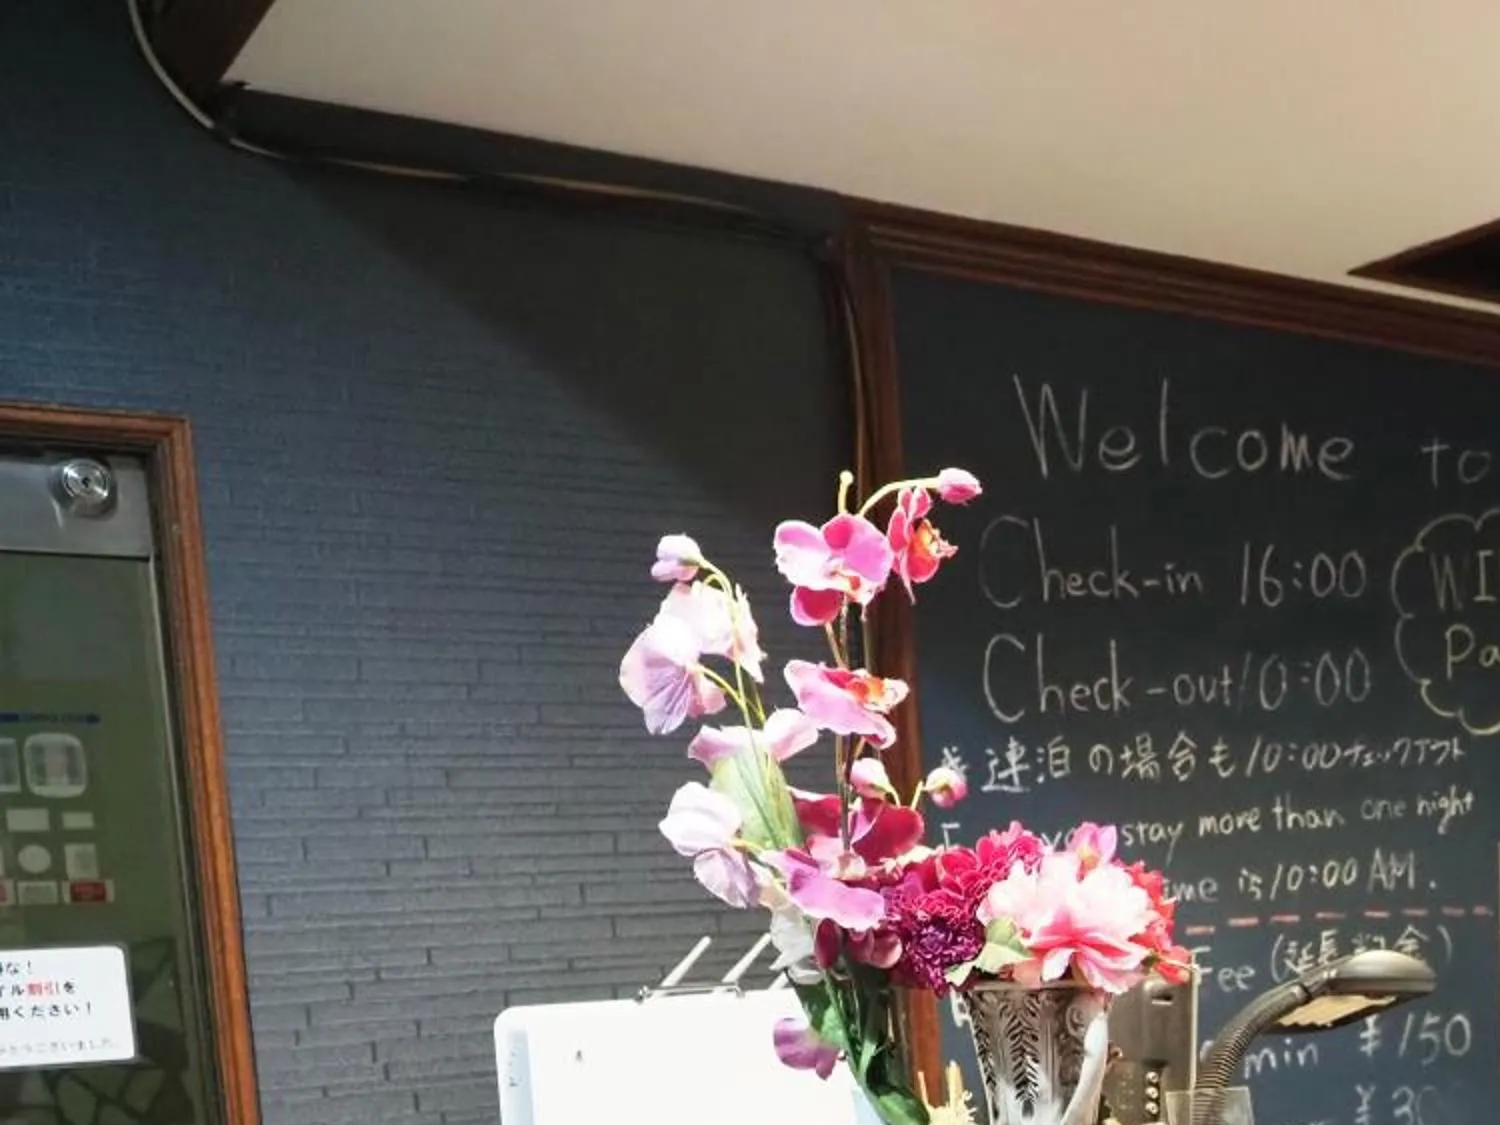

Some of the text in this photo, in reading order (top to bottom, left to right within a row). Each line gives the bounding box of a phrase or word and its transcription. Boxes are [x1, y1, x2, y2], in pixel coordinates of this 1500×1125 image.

[1013, 373, 1356, 481] Welcome
[1421, 436, 1490, 488] to
[979, 515, 1367, 608] Check-in 16:00
[1120, 819, 1184, 865] stay
[1198, 806, 1262, 838] more
[1272, 796, 1346, 836] than
[1360, 795, 1406, 822] one
[1416, 785, 1475, 834] night
[1161, 877, 1219, 903] ime
[1270, 859, 1357, 902] 10:00
